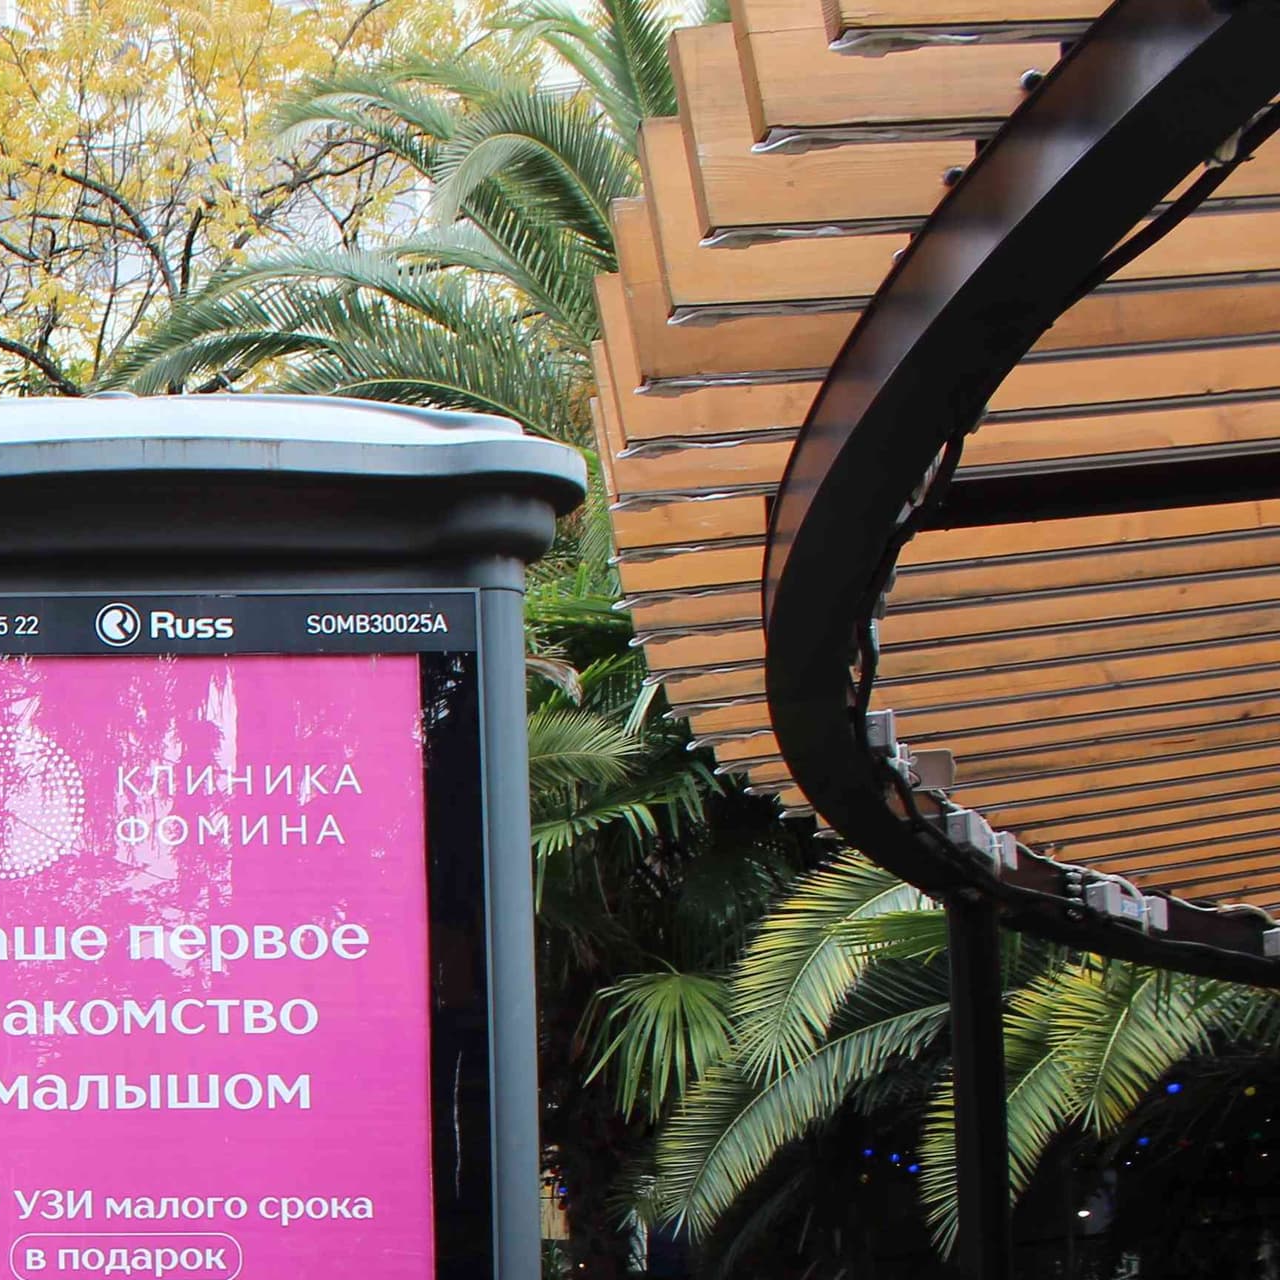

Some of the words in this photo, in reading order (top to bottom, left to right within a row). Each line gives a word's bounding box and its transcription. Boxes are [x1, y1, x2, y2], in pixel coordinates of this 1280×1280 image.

[14, 615, 39, 635] 22
[150, 611, 234, 639] Russ
[307, 613, 448, 634] SOMB30025A
[116, 764, 362, 796] КЛИНИКА
[115, 814, 346, 846] ФОМИНА
[129, 921, 370, 973] первое
[13, 1189, 93, 1220] УЗИ
[105, 1196, 248, 1219] малого
[258, 1196, 374, 1226] срока
[26, 1248, 47, 1270] в
[58, 1247, 228, 1278] подарок
